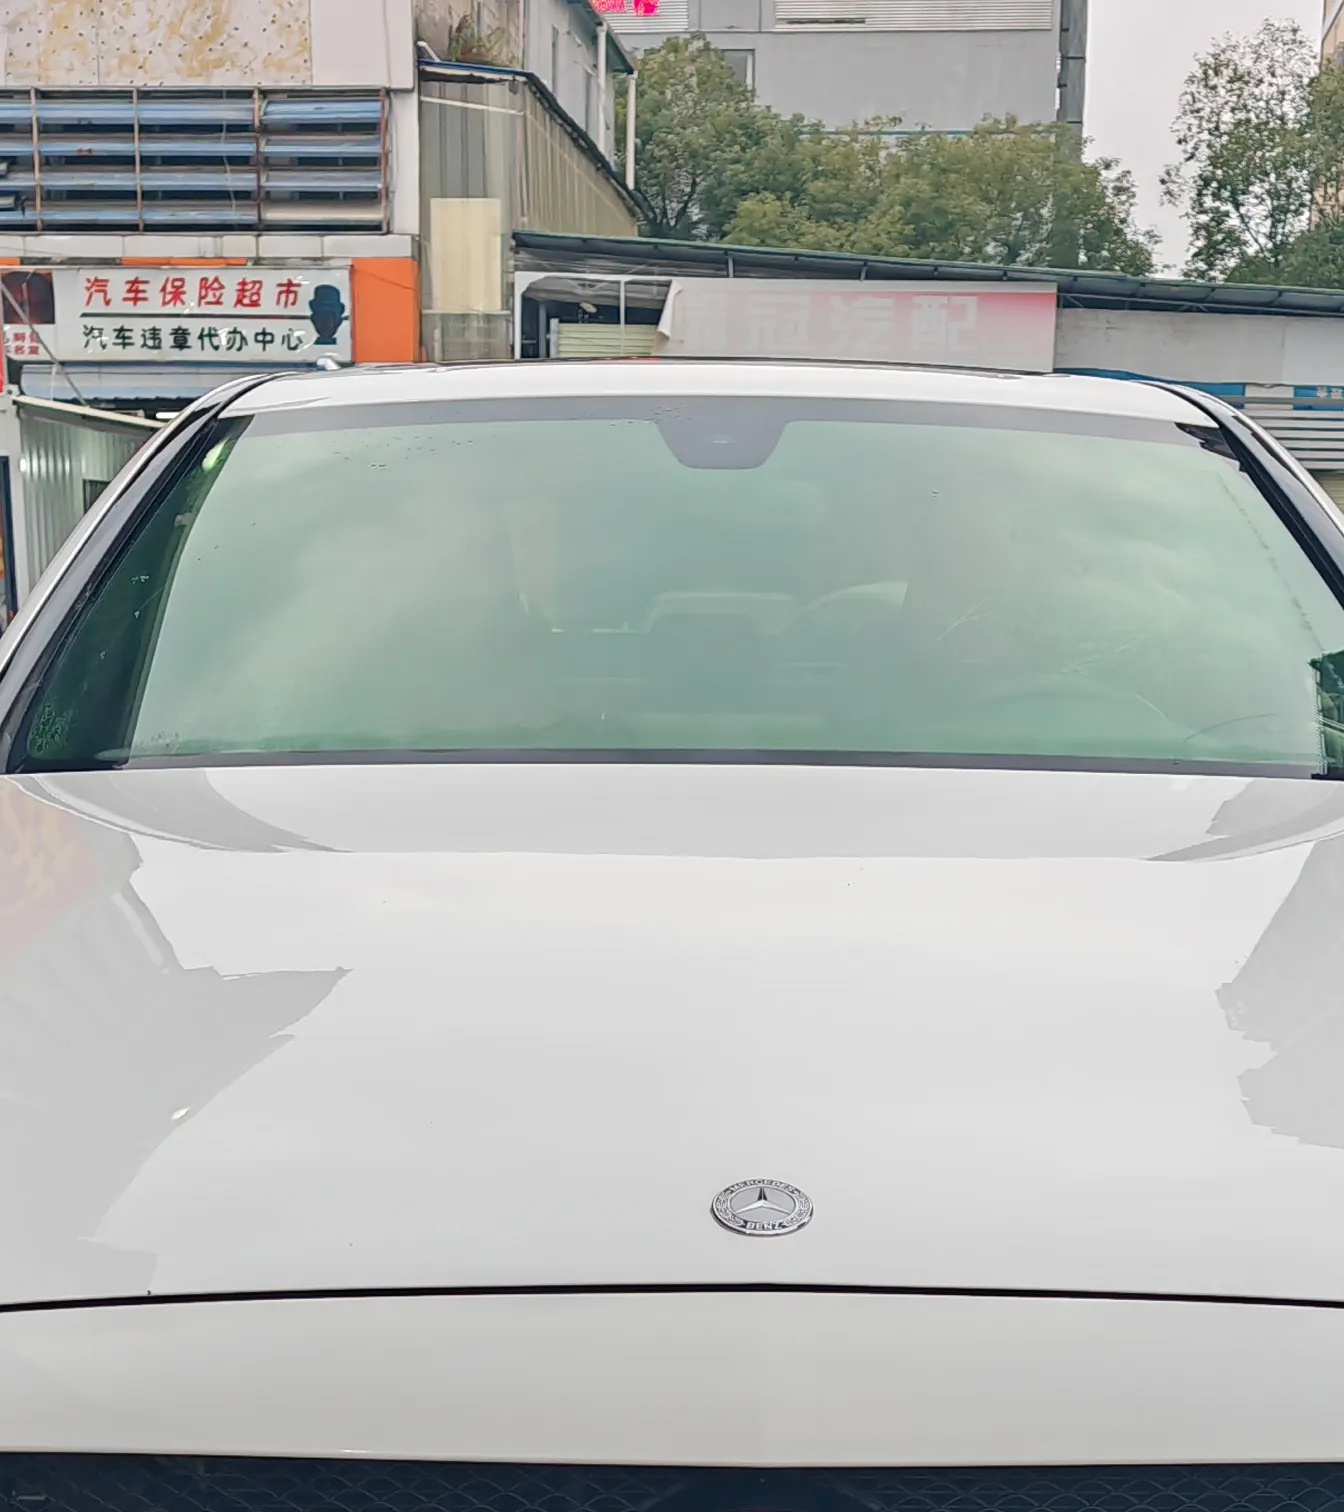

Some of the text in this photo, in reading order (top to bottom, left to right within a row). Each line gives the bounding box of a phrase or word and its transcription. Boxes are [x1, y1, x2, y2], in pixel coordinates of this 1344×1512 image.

[84, 276, 303, 309] 汽车保险超市
[82, 324, 304, 352] 汽车违章代办中心
[746, 1221, 784, 1231] BENZ
